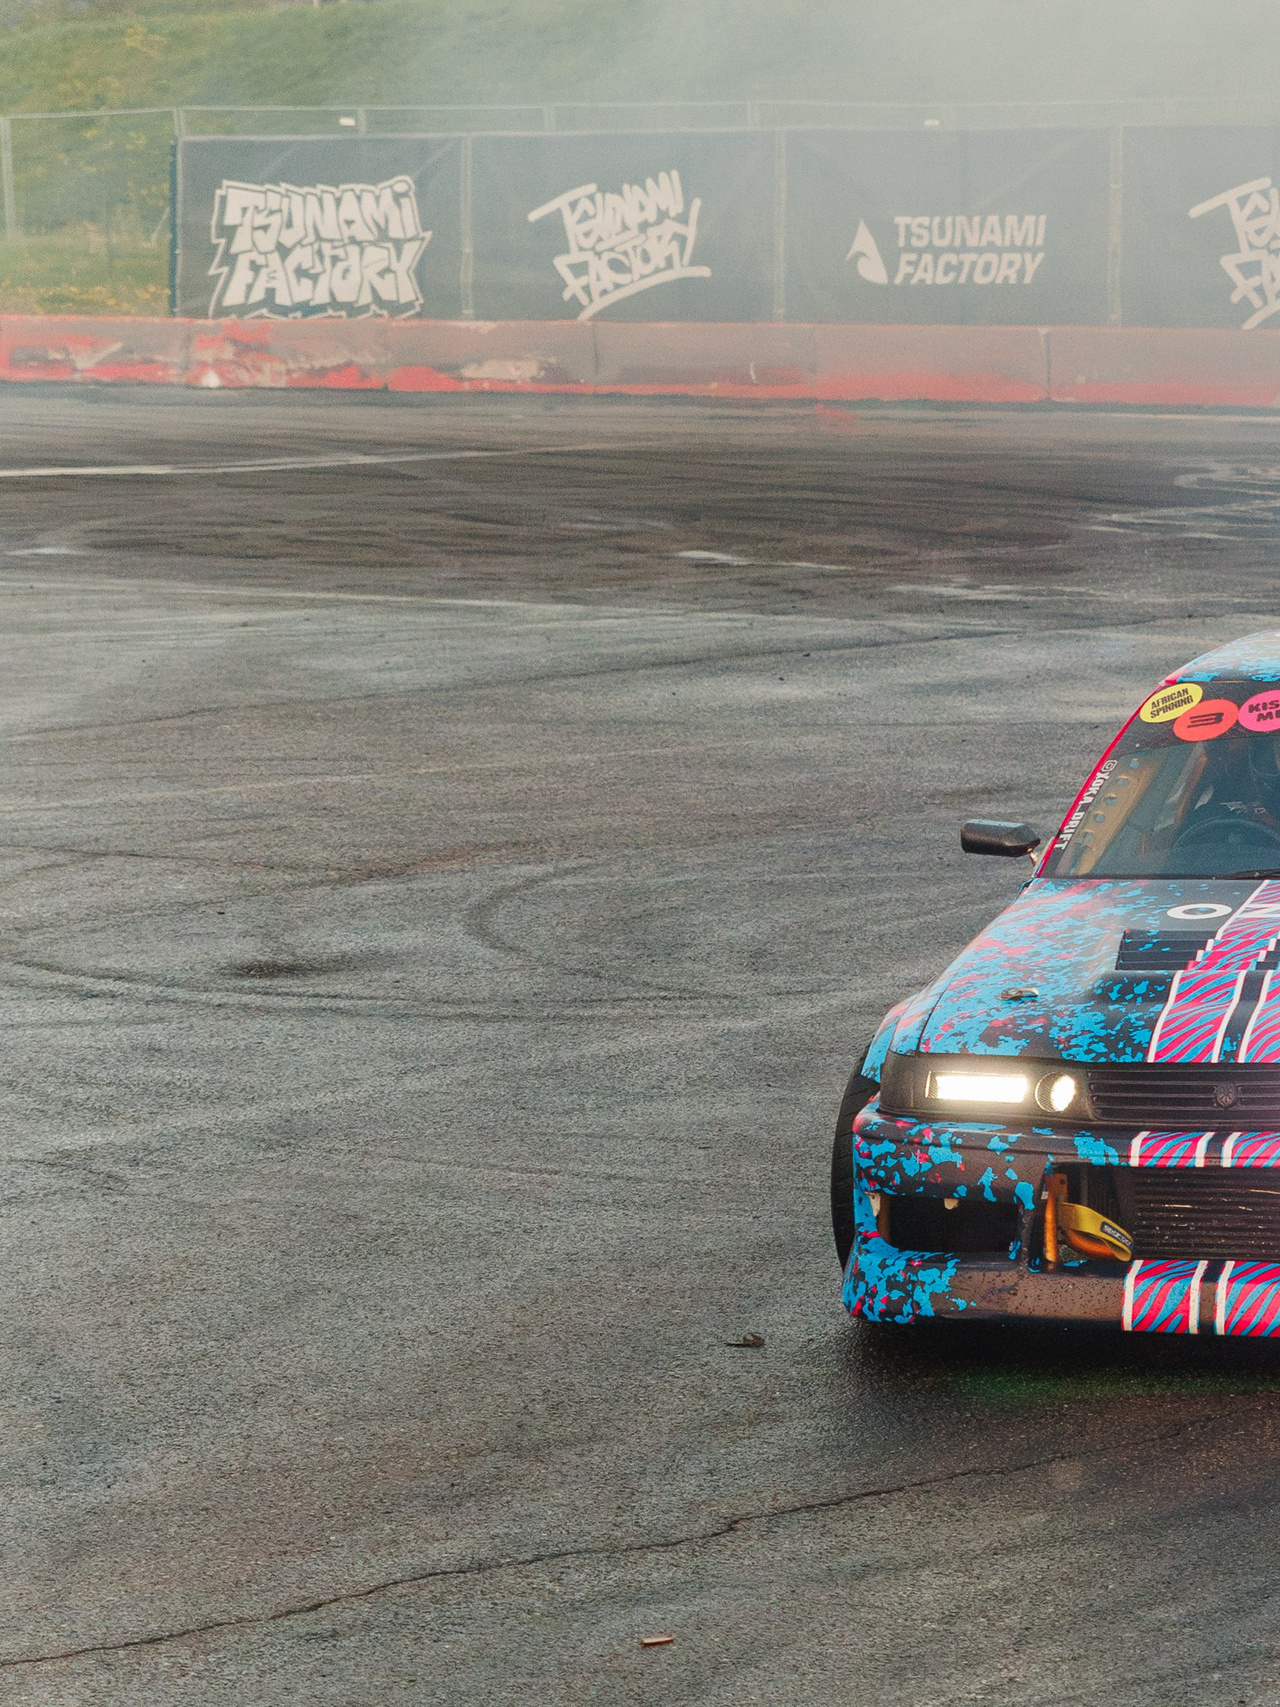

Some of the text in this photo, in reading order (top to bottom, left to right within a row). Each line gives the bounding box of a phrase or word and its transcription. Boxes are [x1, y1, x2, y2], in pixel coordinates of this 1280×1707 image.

[893, 214, 1047, 249] TSUNAMI
[221, 240, 420, 306] FACTORY
[893, 251, 1046, 285] FACTORY
[1150, 695, 1194, 719] SPINNING
[1151, 687, 1189, 708] AFRICAN
[1054, 760, 1118, 850] @XOKA_DRIFT
